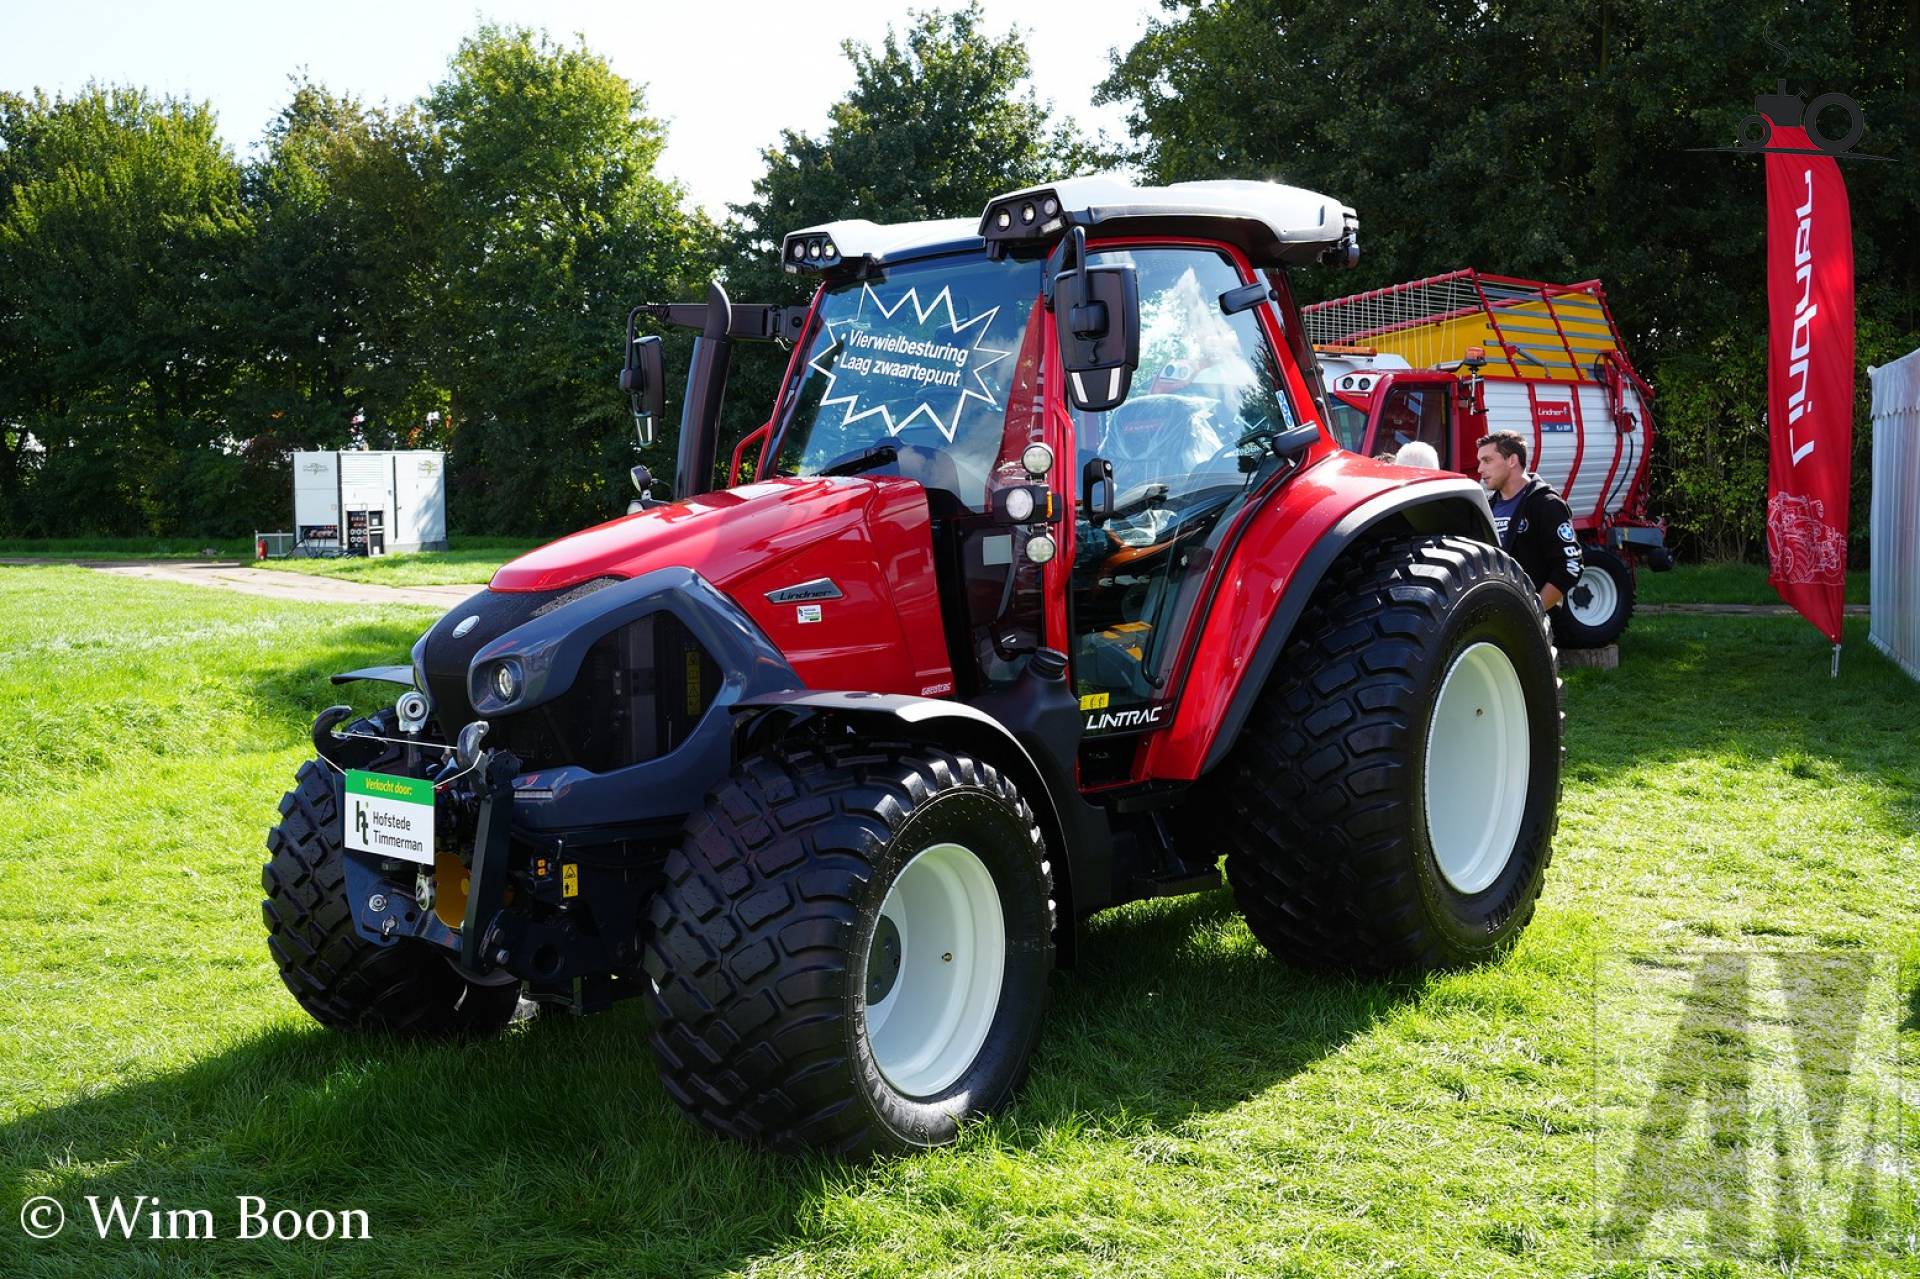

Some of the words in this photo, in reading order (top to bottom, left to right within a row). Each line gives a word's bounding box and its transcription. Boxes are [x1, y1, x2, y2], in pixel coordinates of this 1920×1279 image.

[849, 329, 968, 367] Vierwielbesturing
[840, 352, 871, 375] Laag
[873, 359, 961, 387] zwaartepunt
[1537, 407, 1563, 416] Lindner
[780, 590, 831, 601] Lindner
[1086, 705, 1162, 730] LINTRAC
[365, 778, 393, 792] Verkocht
[372, 811, 411, 831] Hofstede
[373, 830, 423, 852] Timmerman
